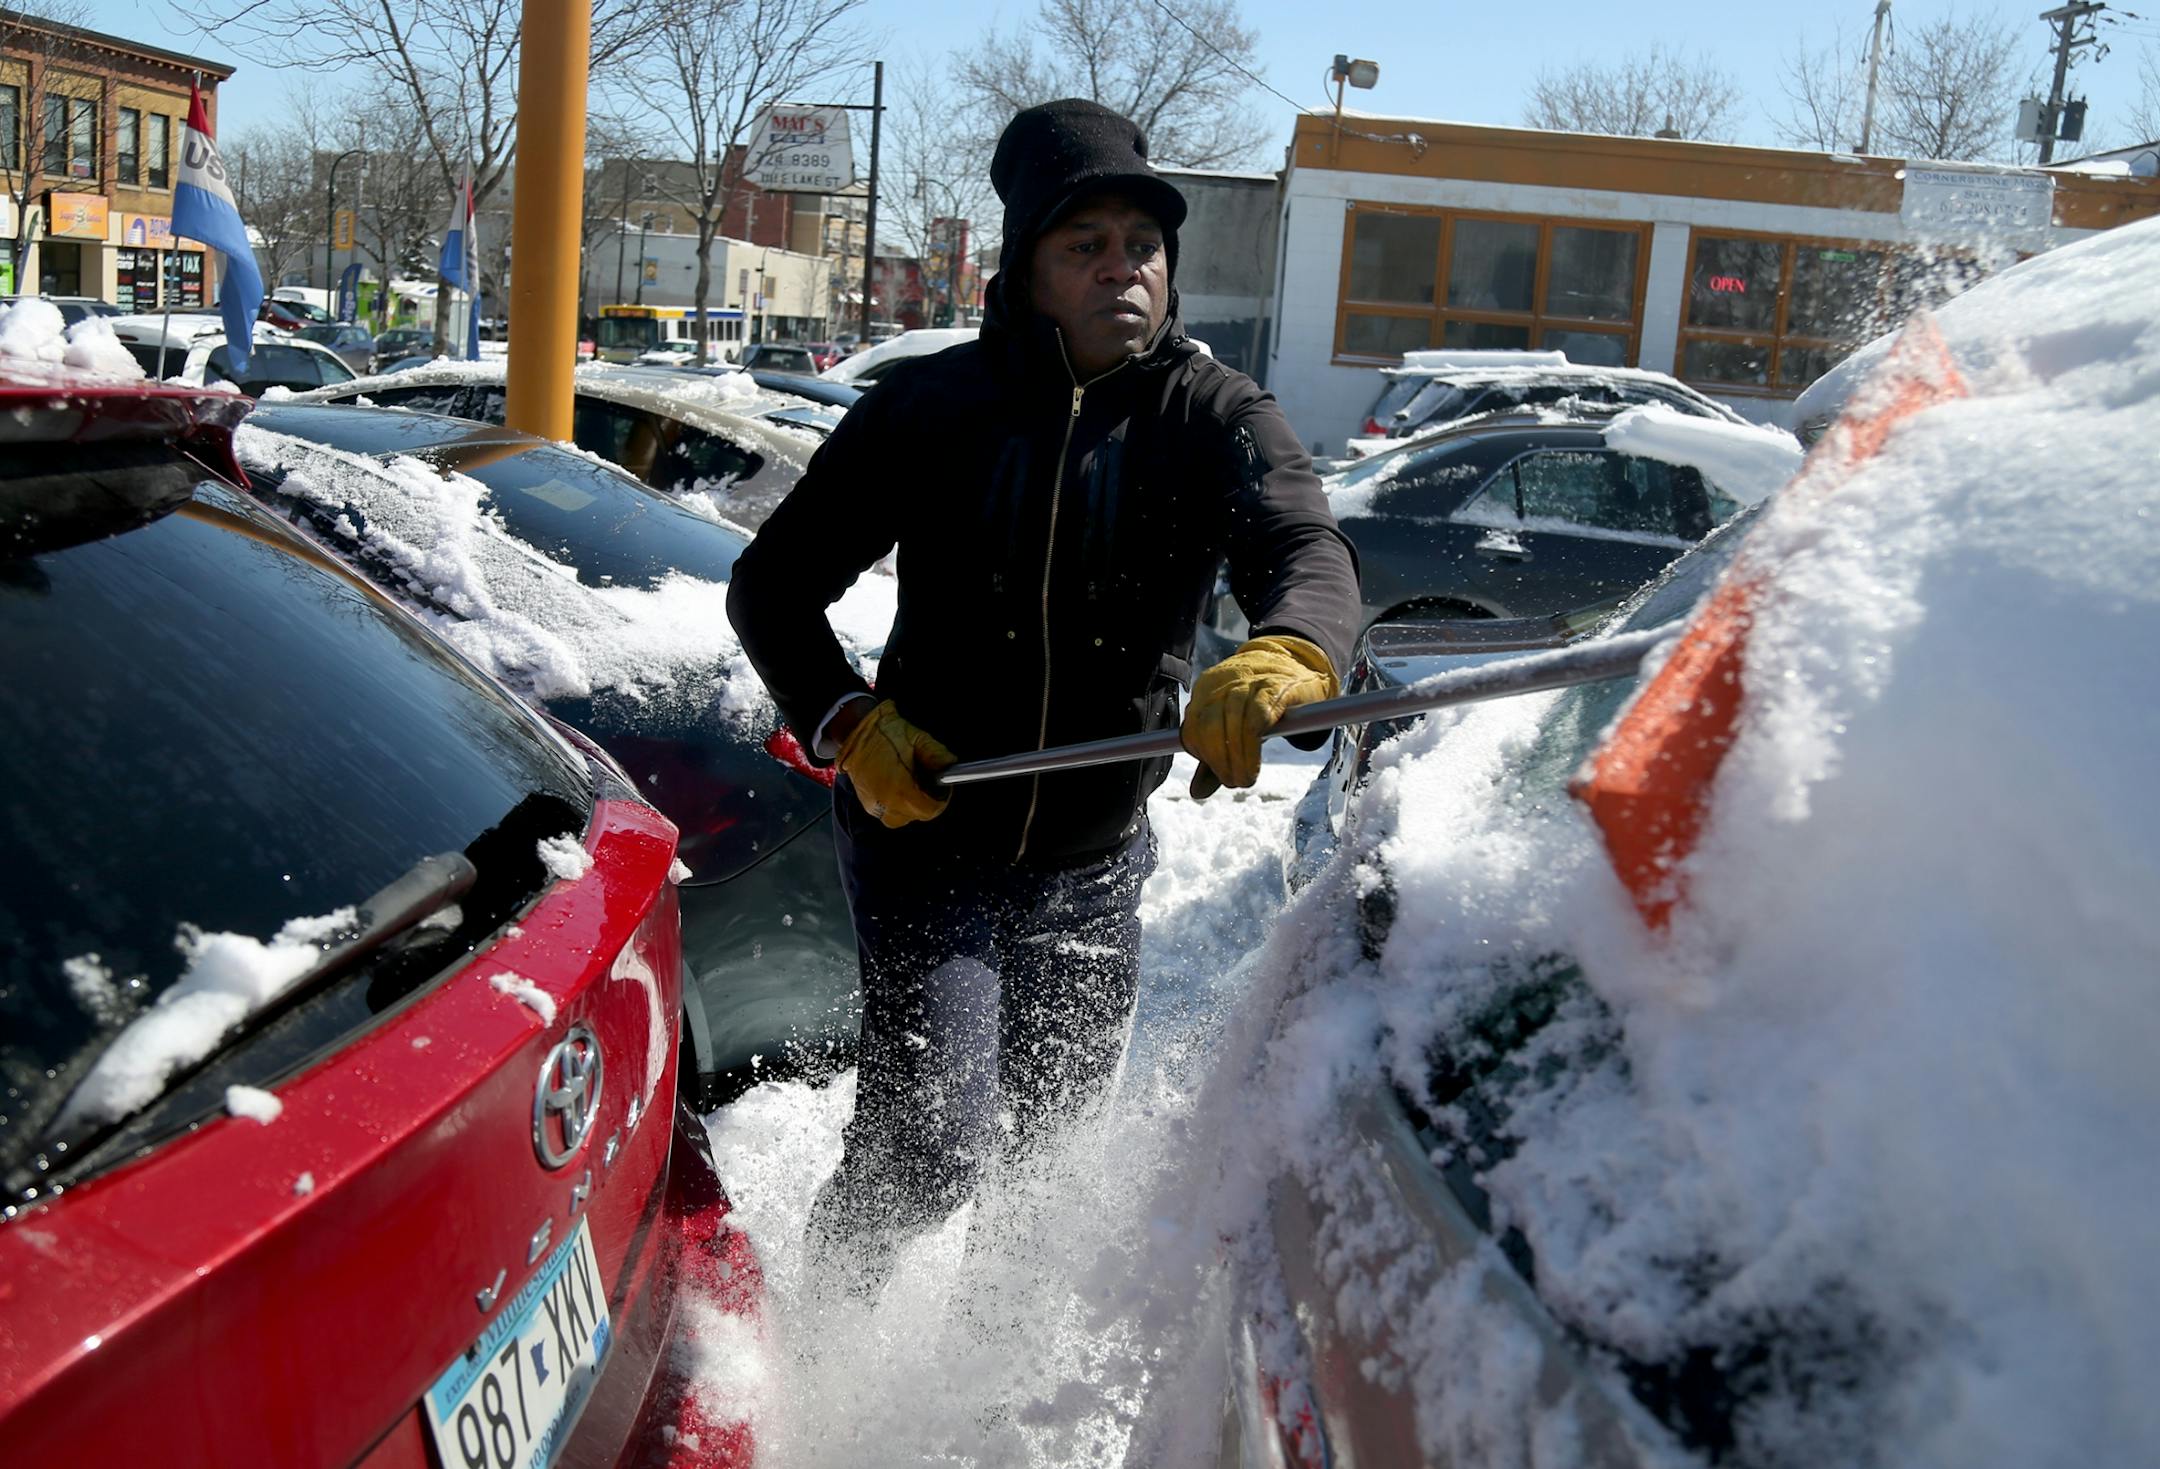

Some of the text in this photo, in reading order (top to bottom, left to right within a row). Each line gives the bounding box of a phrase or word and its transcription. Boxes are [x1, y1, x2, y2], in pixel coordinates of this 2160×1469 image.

[791, 153, 830, 169] 8389
[793, 173, 821, 187] LAKE
[825, 176, 841, 188] ST
[1914, 172, 2009, 187] CORNERSTONE
[1963, 190, 2006, 201] SALES
[182, 254, 201, 274] TAX
[1710, 276, 1745, 293] OPEN
[457, 1234, 598, 1469] 987 XKV
